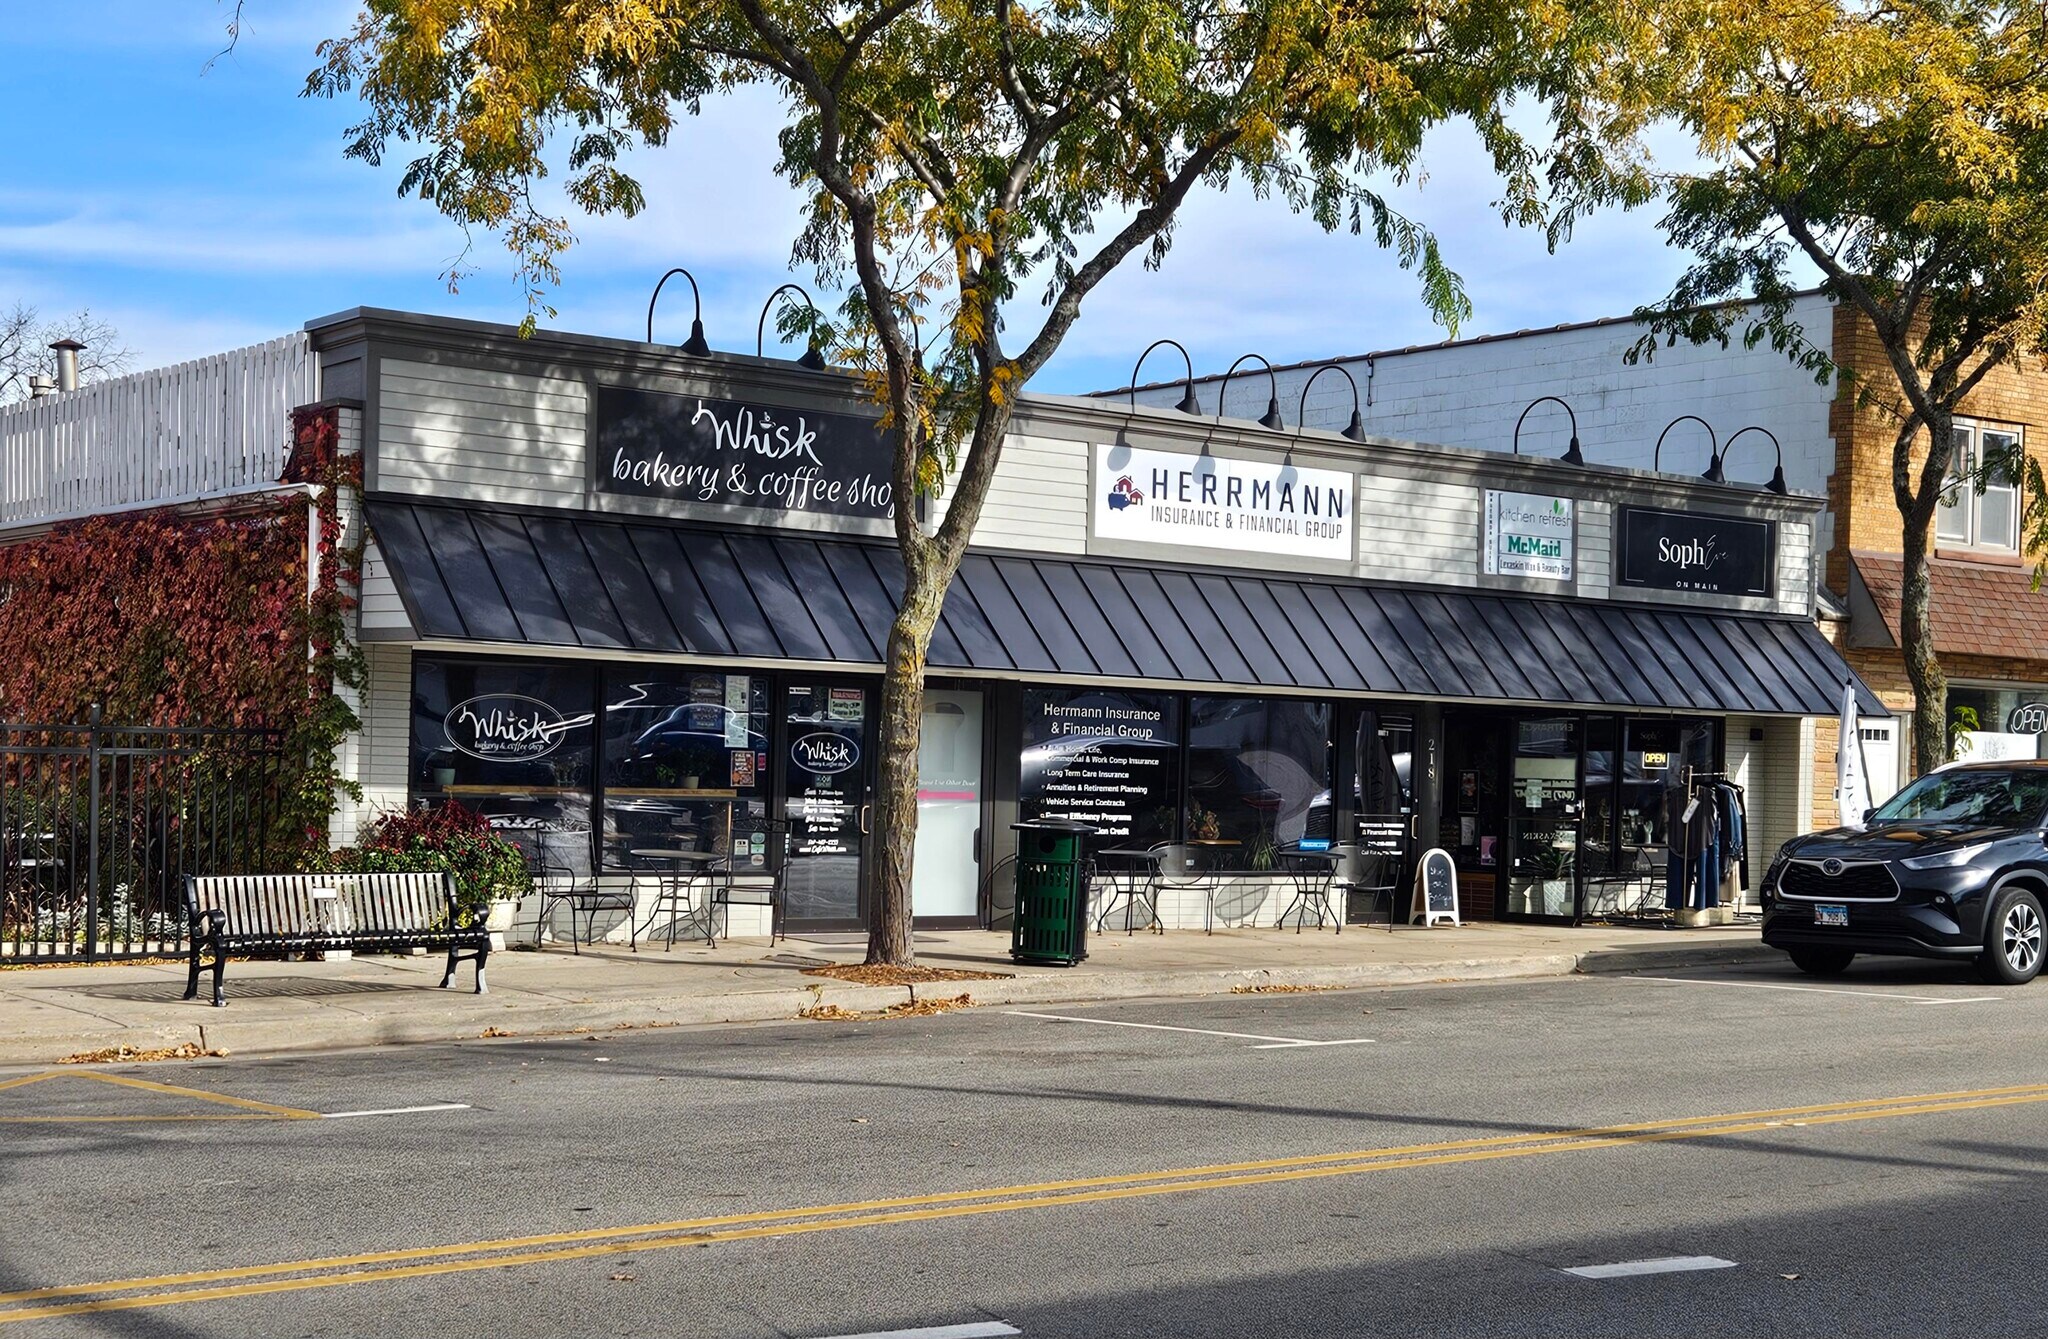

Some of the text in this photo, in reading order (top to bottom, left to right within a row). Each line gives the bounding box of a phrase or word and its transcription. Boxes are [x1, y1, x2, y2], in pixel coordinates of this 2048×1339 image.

[692, 400, 823, 466] Whisk
[612, 447, 720, 501] bakery
[726, 463, 755, 496] &
[758, 466, 841, 509] coffee
[1152, 468, 1344, 518] HERRMANN
[1151, 505, 1342, 539] INSURANCE & FINANCIAL GROUP
[1499, 506, 1572, 528] kitchen refresh
[1508, 535, 1562, 557] McMaid
[1658, 537, 1705, 569] Soph
[1676, 580, 1719, 590] ON MAIN
[1044, 703, 1161, 721] Herrmann Insurance
[2012, 708, 2048, 732] OPEN
[458, 706, 551, 744] Whisk
[1051, 722, 1153, 741] & Financial Group
[799, 741, 850, 763] Whisk
[1109, 757, 1127, 765] Comp
[1129, 757, 1159, 766] Insurance
[1645, 753, 1666, 763] OPEN
[1047, 769, 1063, 778] Long
[1064, 769, 1081, 777] Term
[1077, 784, 1082, 792] &
[1083, 784, 1119, 792] Retirement
[1120, 785, 1148, 795] Planning
[1046, 798, 1126, 807] Vehicle Service Contracts
